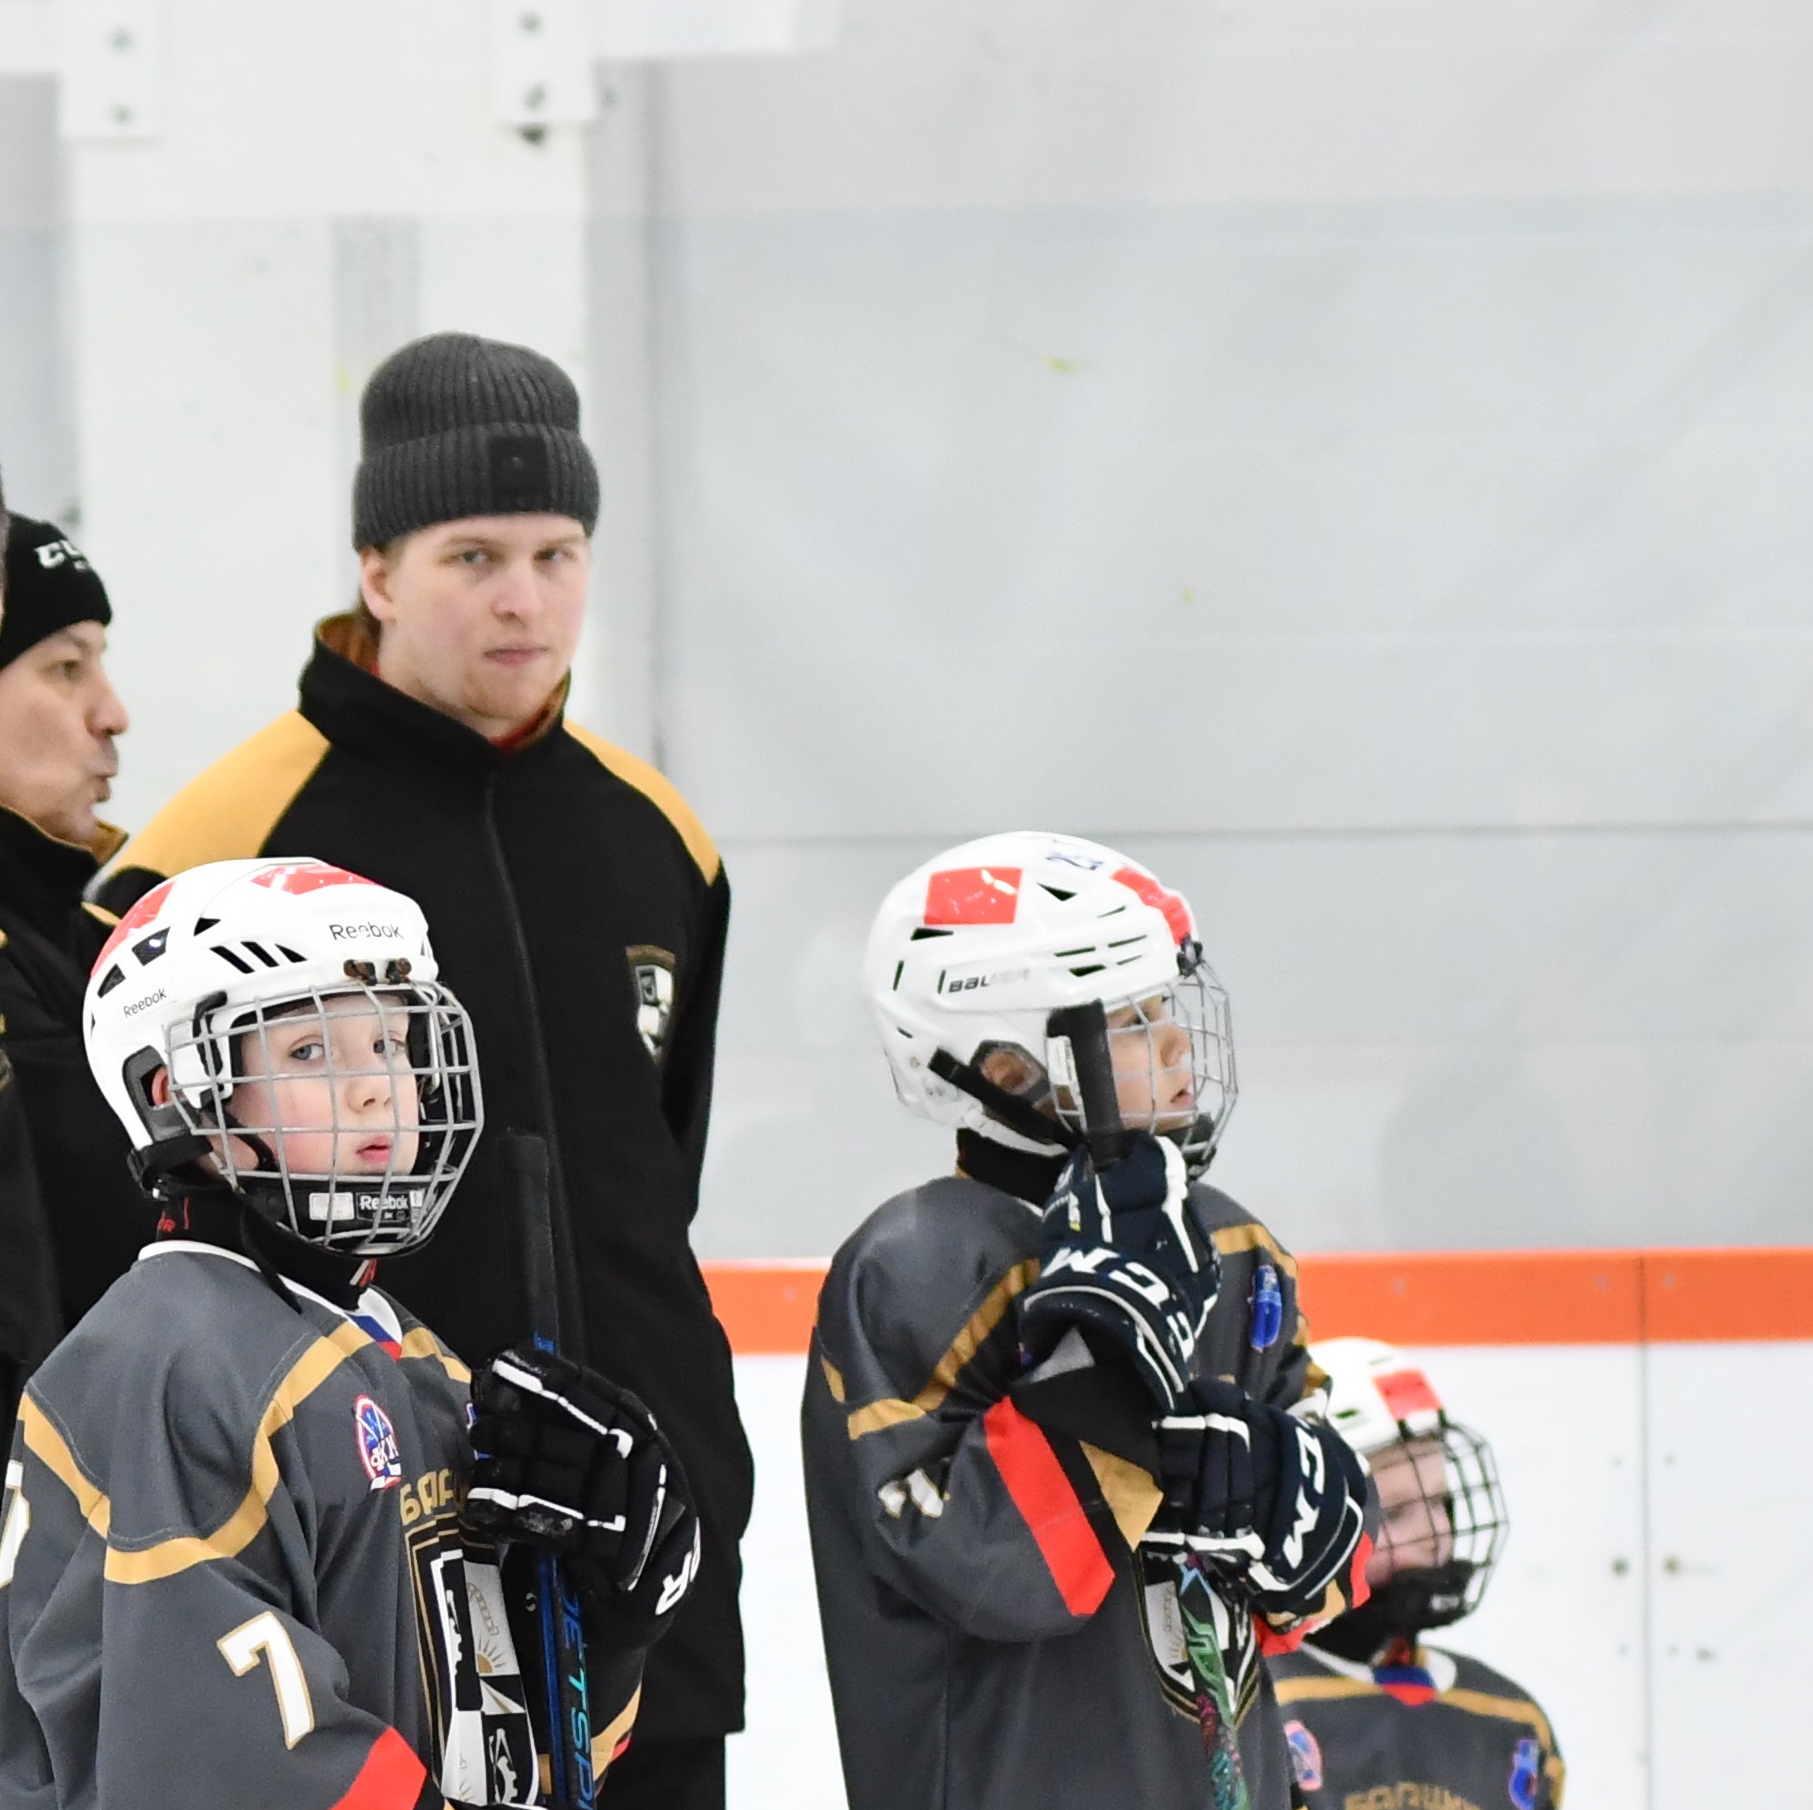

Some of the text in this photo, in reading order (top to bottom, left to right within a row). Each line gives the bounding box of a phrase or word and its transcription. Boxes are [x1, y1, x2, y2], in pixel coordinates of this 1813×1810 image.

[328, 922, 405, 942] Reebok
[122, 987, 168, 1019] Reebok
[1281, 1416, 1326, 1570] CM
[217, 1612, 314, 1750] 7
